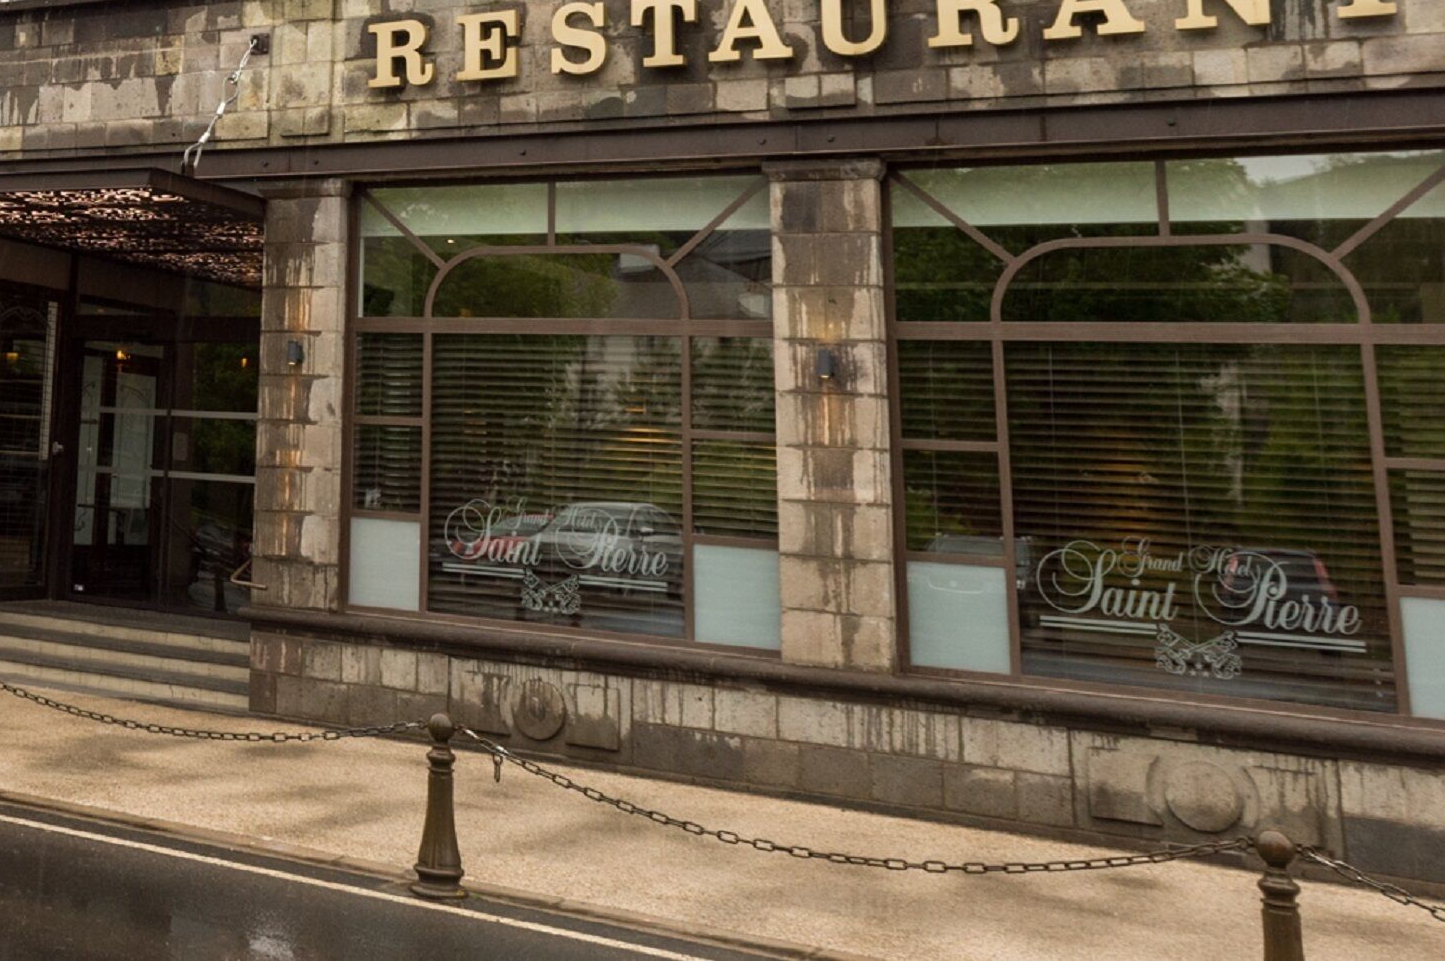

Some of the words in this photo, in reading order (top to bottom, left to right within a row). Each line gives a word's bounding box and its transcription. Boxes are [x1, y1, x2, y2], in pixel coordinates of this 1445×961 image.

[444, 499, 543, 567] Saint
[555, 508, 669, 576] Pierre
[1116, 535, 1185, 578] Grand
[1037, 540, 1180, 621] Saint
[1194, 551, 1363, 635] Pierre
